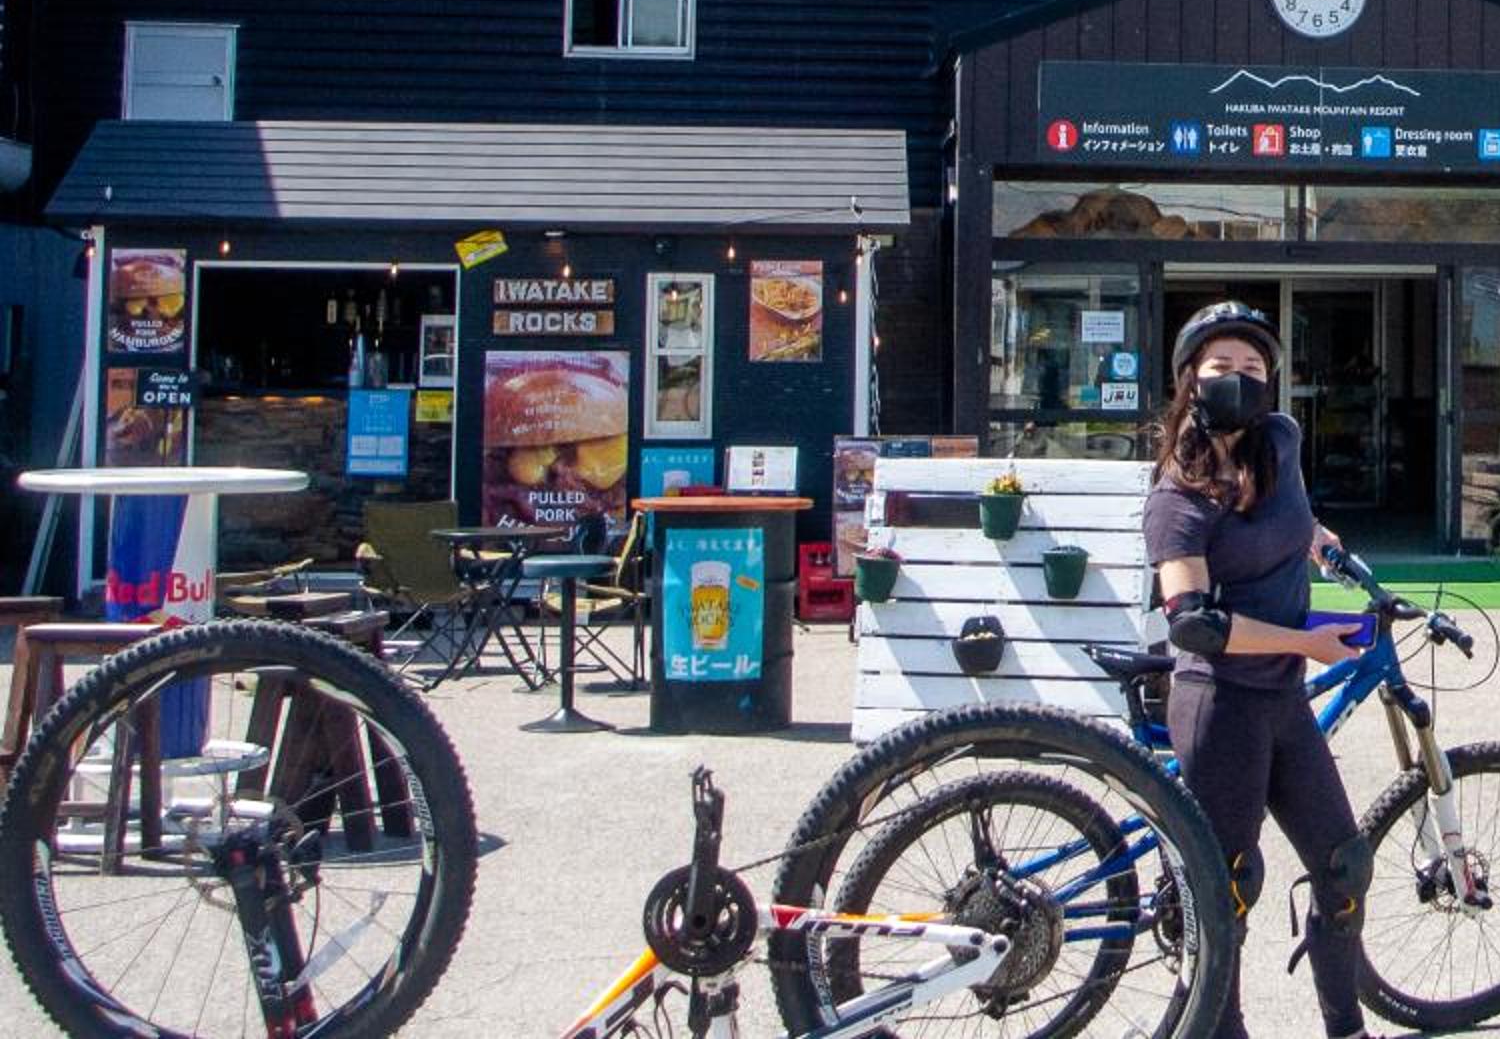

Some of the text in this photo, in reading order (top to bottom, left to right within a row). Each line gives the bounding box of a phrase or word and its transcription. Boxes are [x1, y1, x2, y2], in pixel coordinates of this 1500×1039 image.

[1225, 103, 1405, 116] HAKUBA IWATAKE MOUNTAIN RESORT
[1082, 121, 1149, 135] Information
[1206, 123, 1248, 138] Toilets
[1289, 126, 1321, 140] Shop
[1395, 128, 1473, 142] Dressing room
[1082, 140, 1165, 153] インフォメーション
[1208, 142, 1241, 154] トイレ
[499, 279, 608, 301] IWATAKE
[509, 312, 598, 333] ROCKS
[143, 391, 191, 404] OPEN
[528, 491, 585, 504] PULLED
[535, 508, 577, 522] PORK
[106, 568, 161, 605] Red
[670, 654, 760, 676] 生ビール
